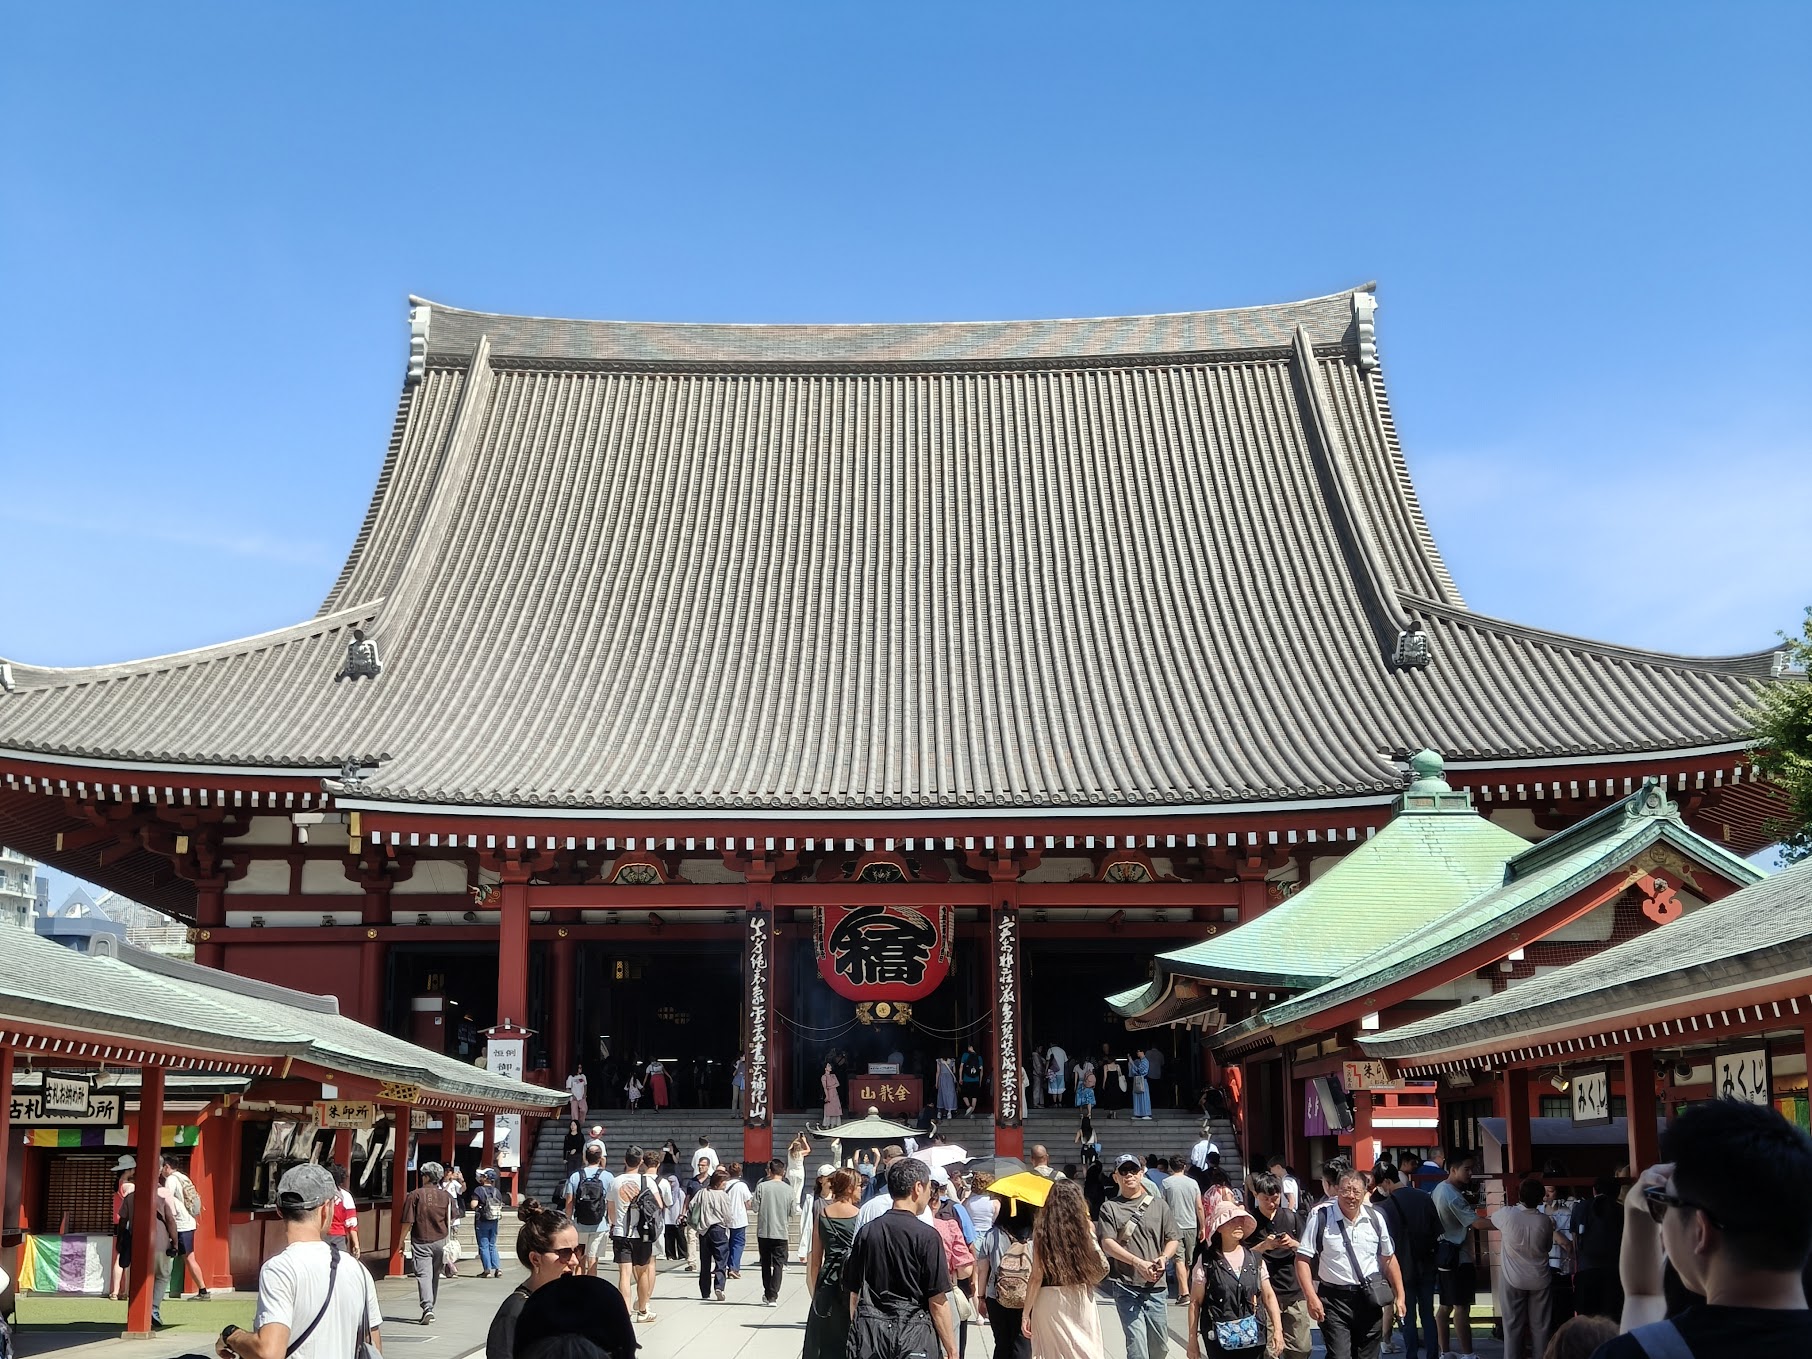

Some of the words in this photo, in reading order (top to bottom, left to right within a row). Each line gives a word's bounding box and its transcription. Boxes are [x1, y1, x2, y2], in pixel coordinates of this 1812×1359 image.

[46, 1082, 85, 1106] 古札お納め所
[329, 1105, 369, 1119] 朱印所
